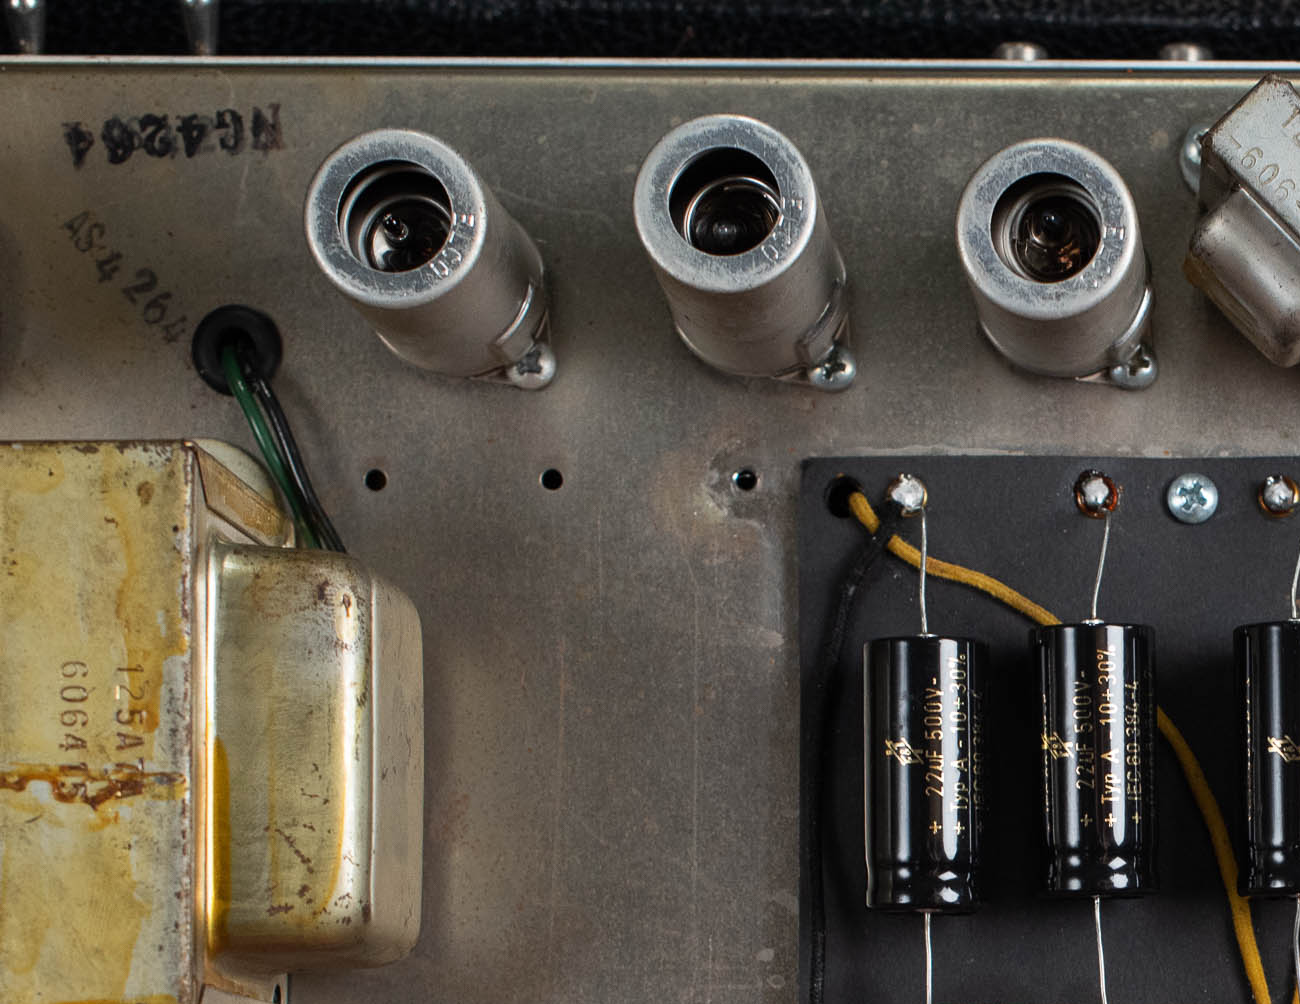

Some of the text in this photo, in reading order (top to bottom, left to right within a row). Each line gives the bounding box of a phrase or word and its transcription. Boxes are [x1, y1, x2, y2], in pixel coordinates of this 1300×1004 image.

[951, 758, 967, 771] A
[1101, 748, 1119, 763] A
[950, 782, 968, 812] Typ
[1101, 773, 1121, 804] Typ
[1127, 771, 1142, 801] IEC
